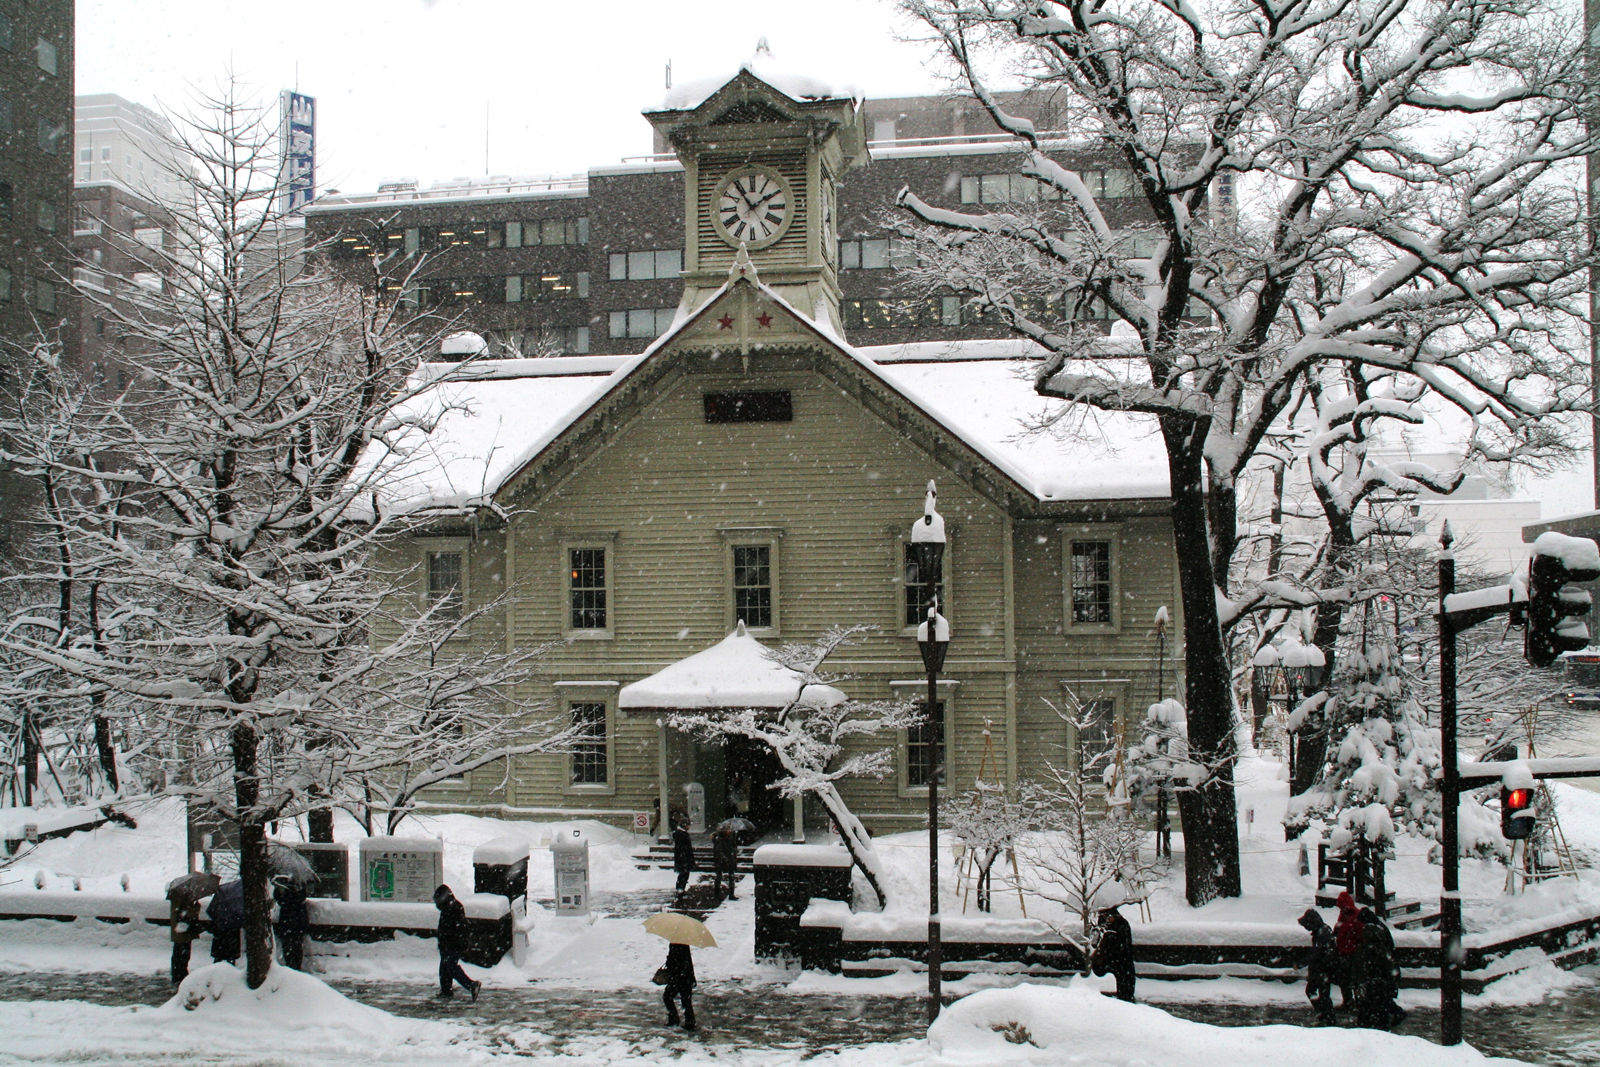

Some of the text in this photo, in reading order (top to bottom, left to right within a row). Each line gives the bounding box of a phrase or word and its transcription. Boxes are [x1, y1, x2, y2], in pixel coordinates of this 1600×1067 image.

[759, 179, 769, 194] I
[723, 191, 740, 203] X
[760, 221, 772, 237] V
